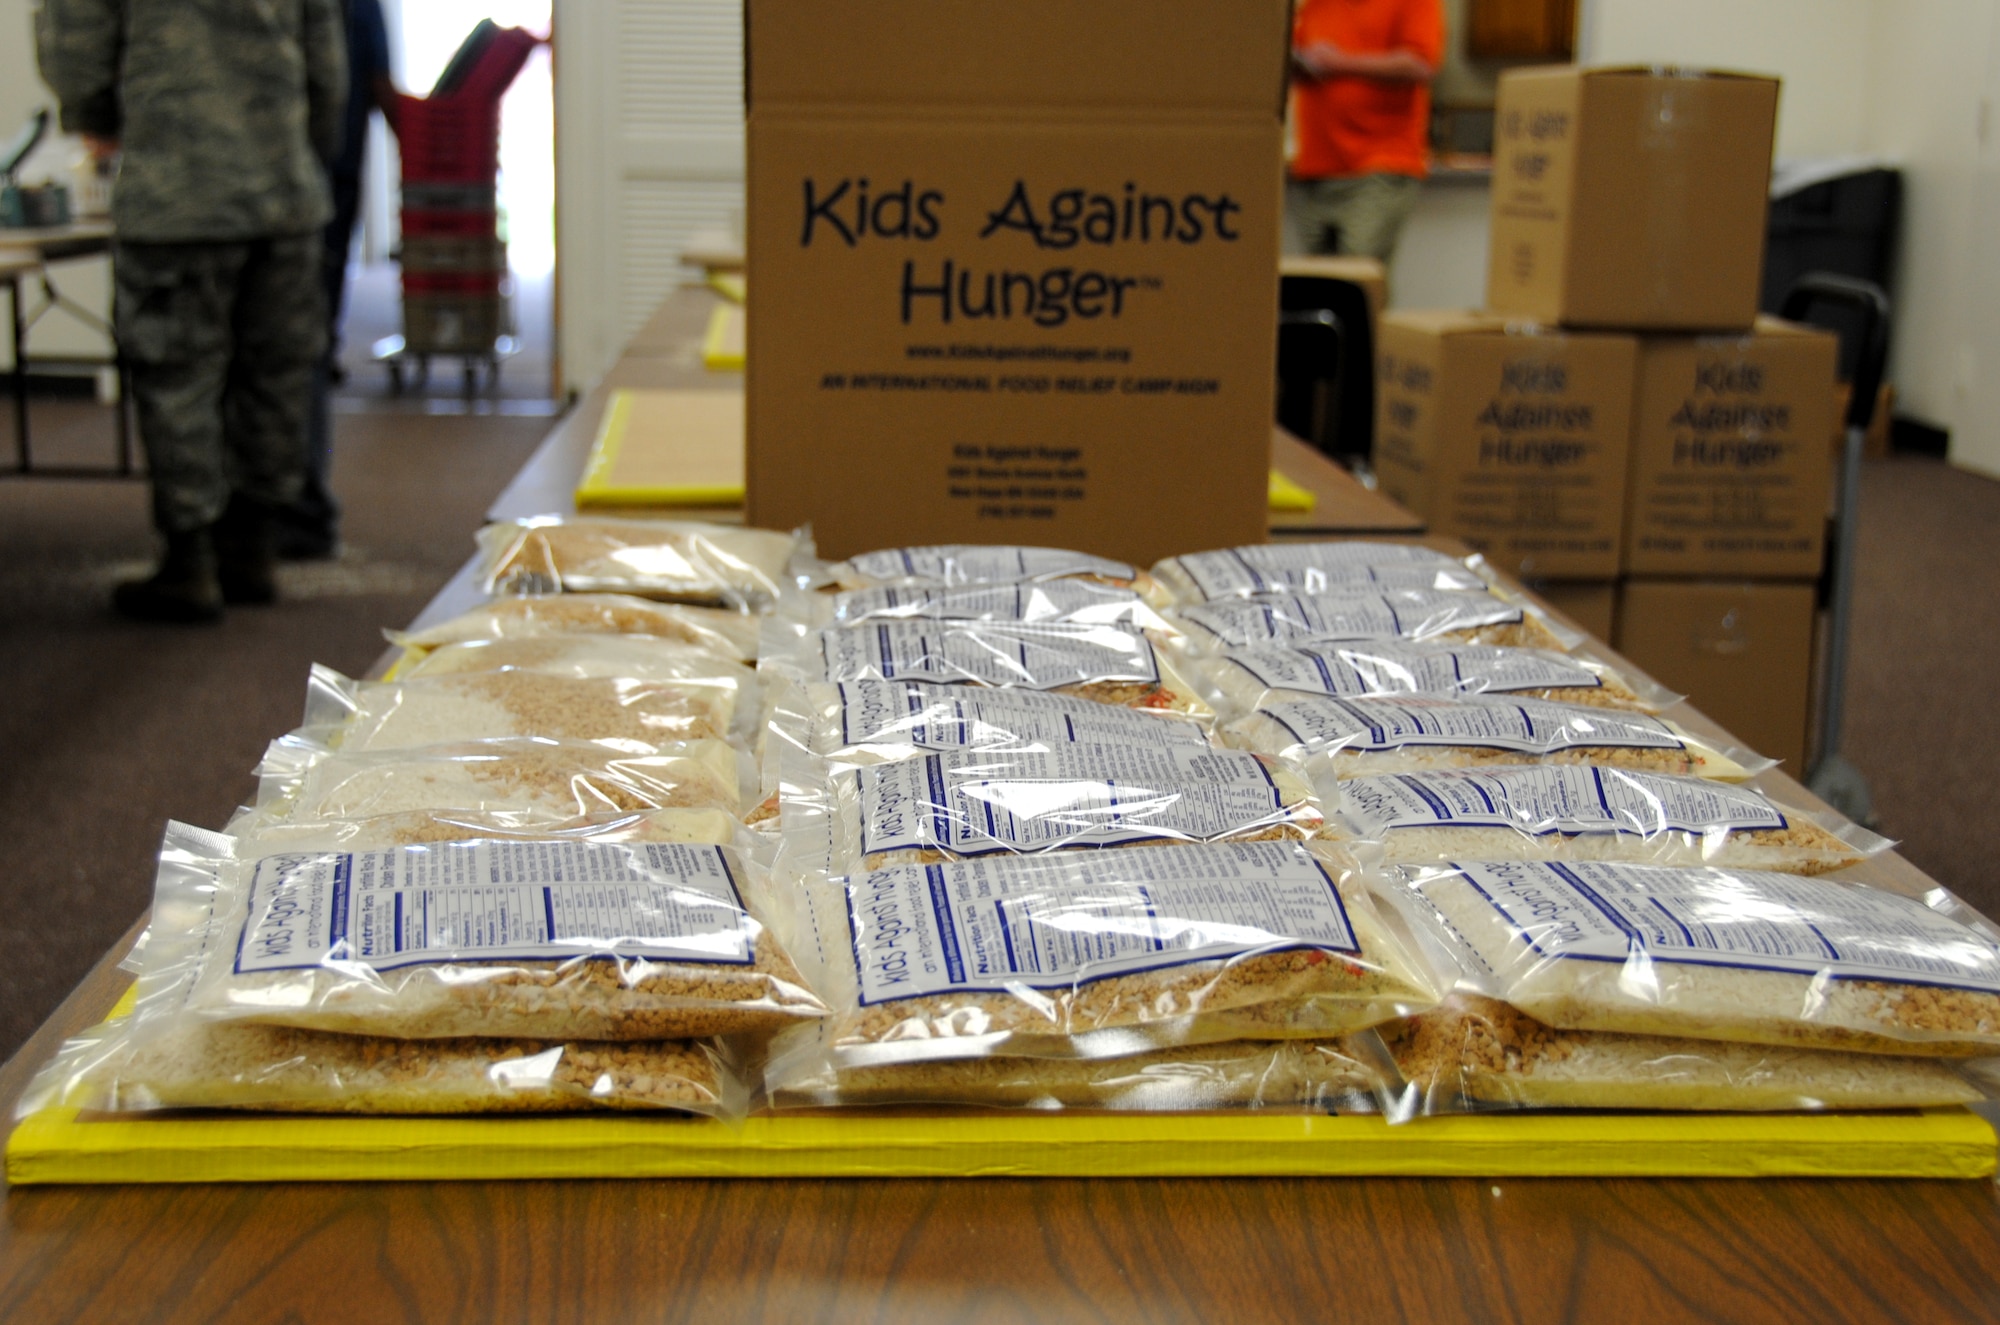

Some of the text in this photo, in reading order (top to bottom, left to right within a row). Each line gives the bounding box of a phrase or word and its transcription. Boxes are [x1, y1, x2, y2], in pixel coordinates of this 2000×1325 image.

[801, 178, 1241, 250] Kids Against
[870, 901, 910, 949] Against
[906, 896, 923, 911] food
[910, 912, 933, 959] international
[964, 905, 989, 974] Nutrition Facts
[923, 959, 937, 973] an
